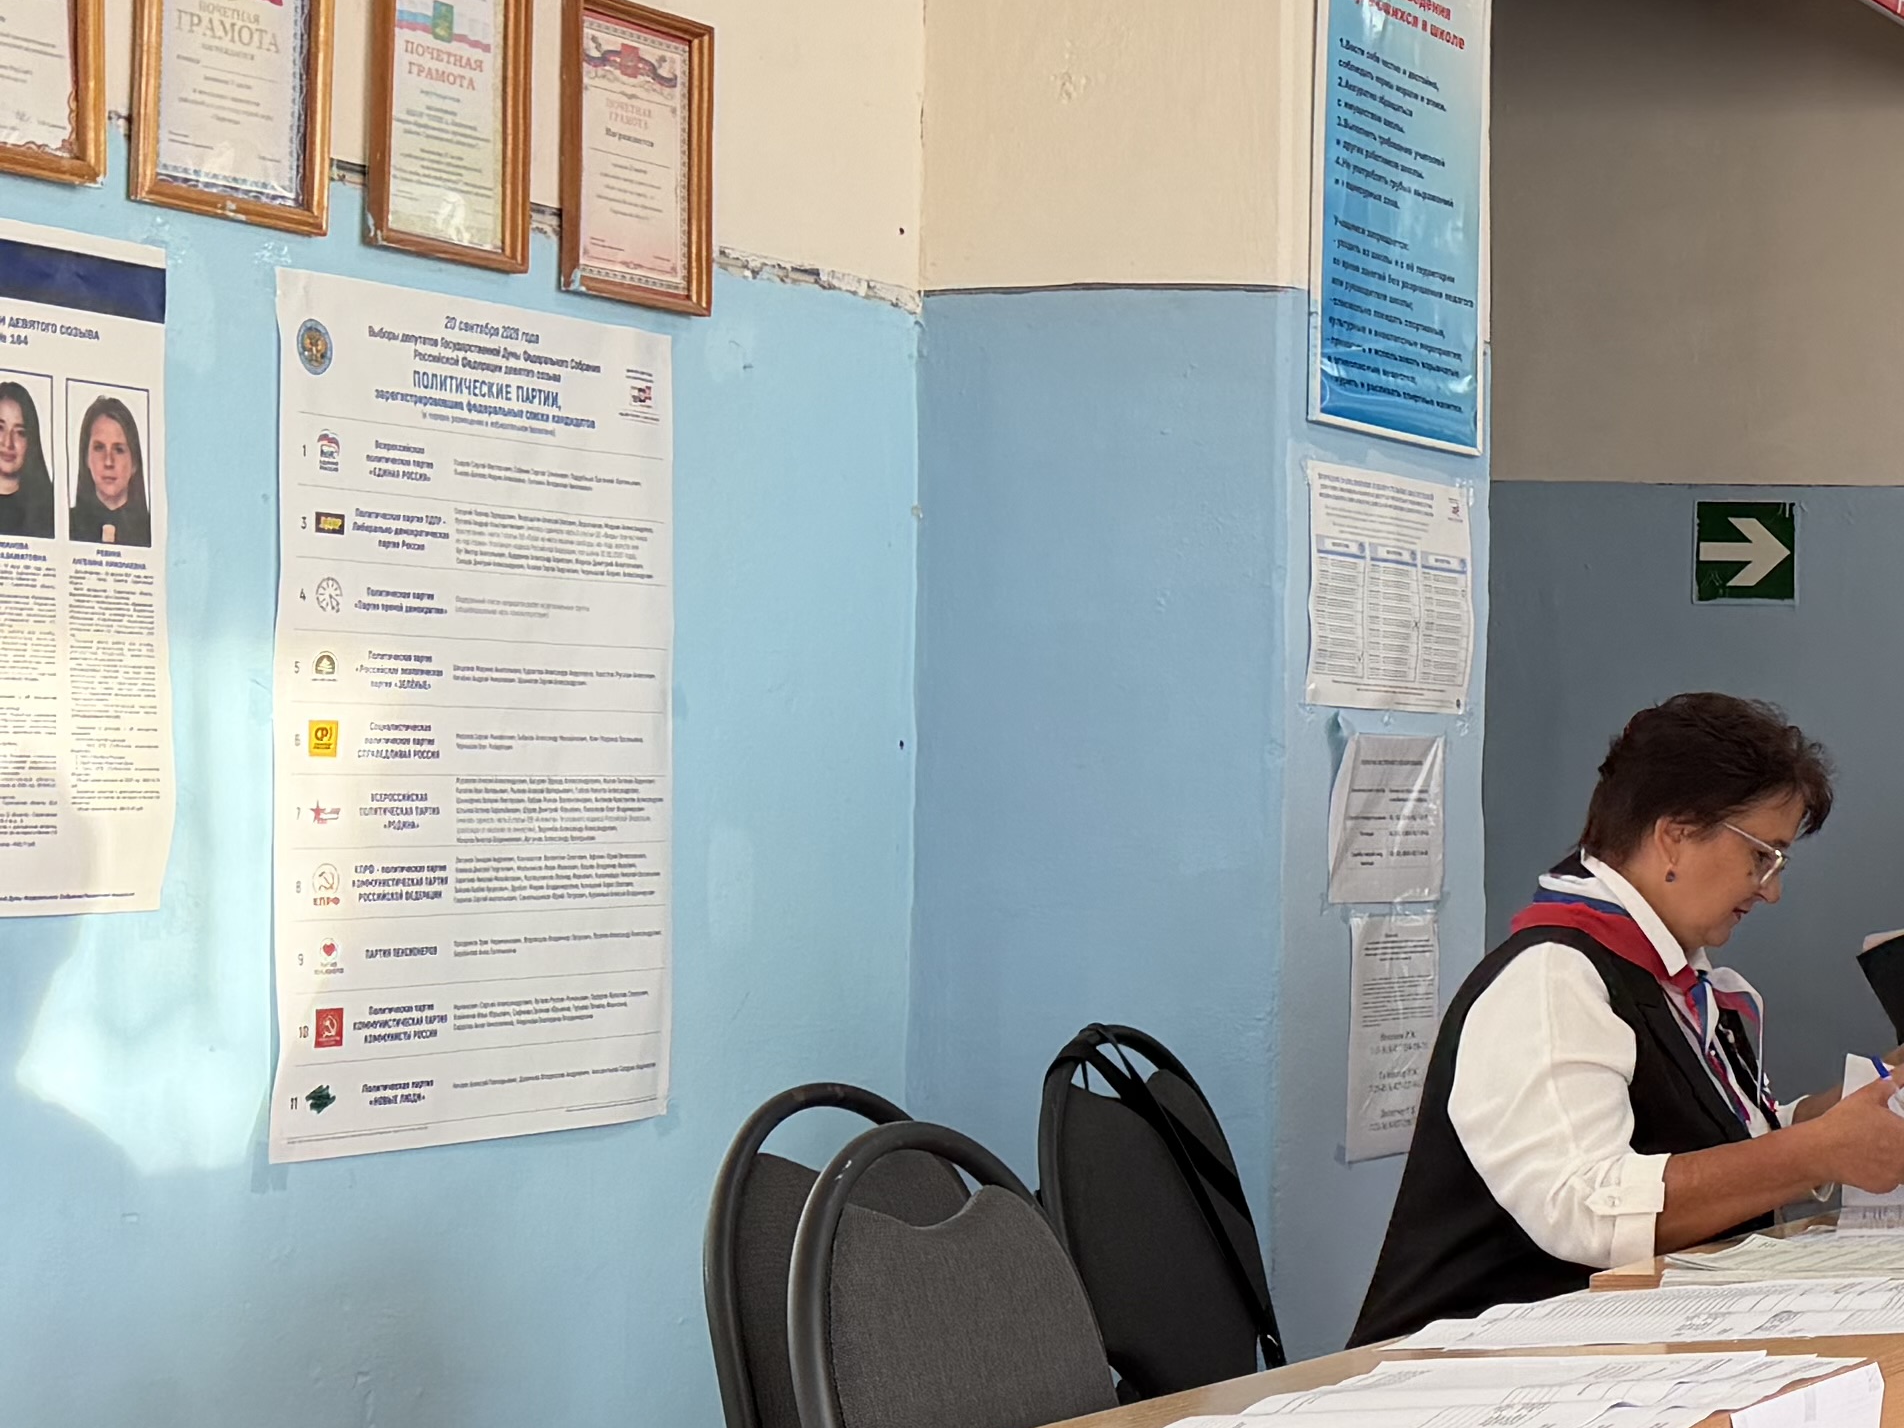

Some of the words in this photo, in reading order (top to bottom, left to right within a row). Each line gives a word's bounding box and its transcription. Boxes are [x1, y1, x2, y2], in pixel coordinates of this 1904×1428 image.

[176, 9, 281, 54] ГРАМОТА
[1421, 19, 1428, 32] в
[1430, 24, 1465, 50] школе
[404, 39, 484, 73] ПОЧЕТНАЯ
[407, 61, 476, 91] ГРАМОТА
[458, 319, 500, 338] сентября
[413, 369, 512, 402] ПОЛИТИЧЕСКИЕ
[516, 384, 562, 411] ПАРТИИ,
